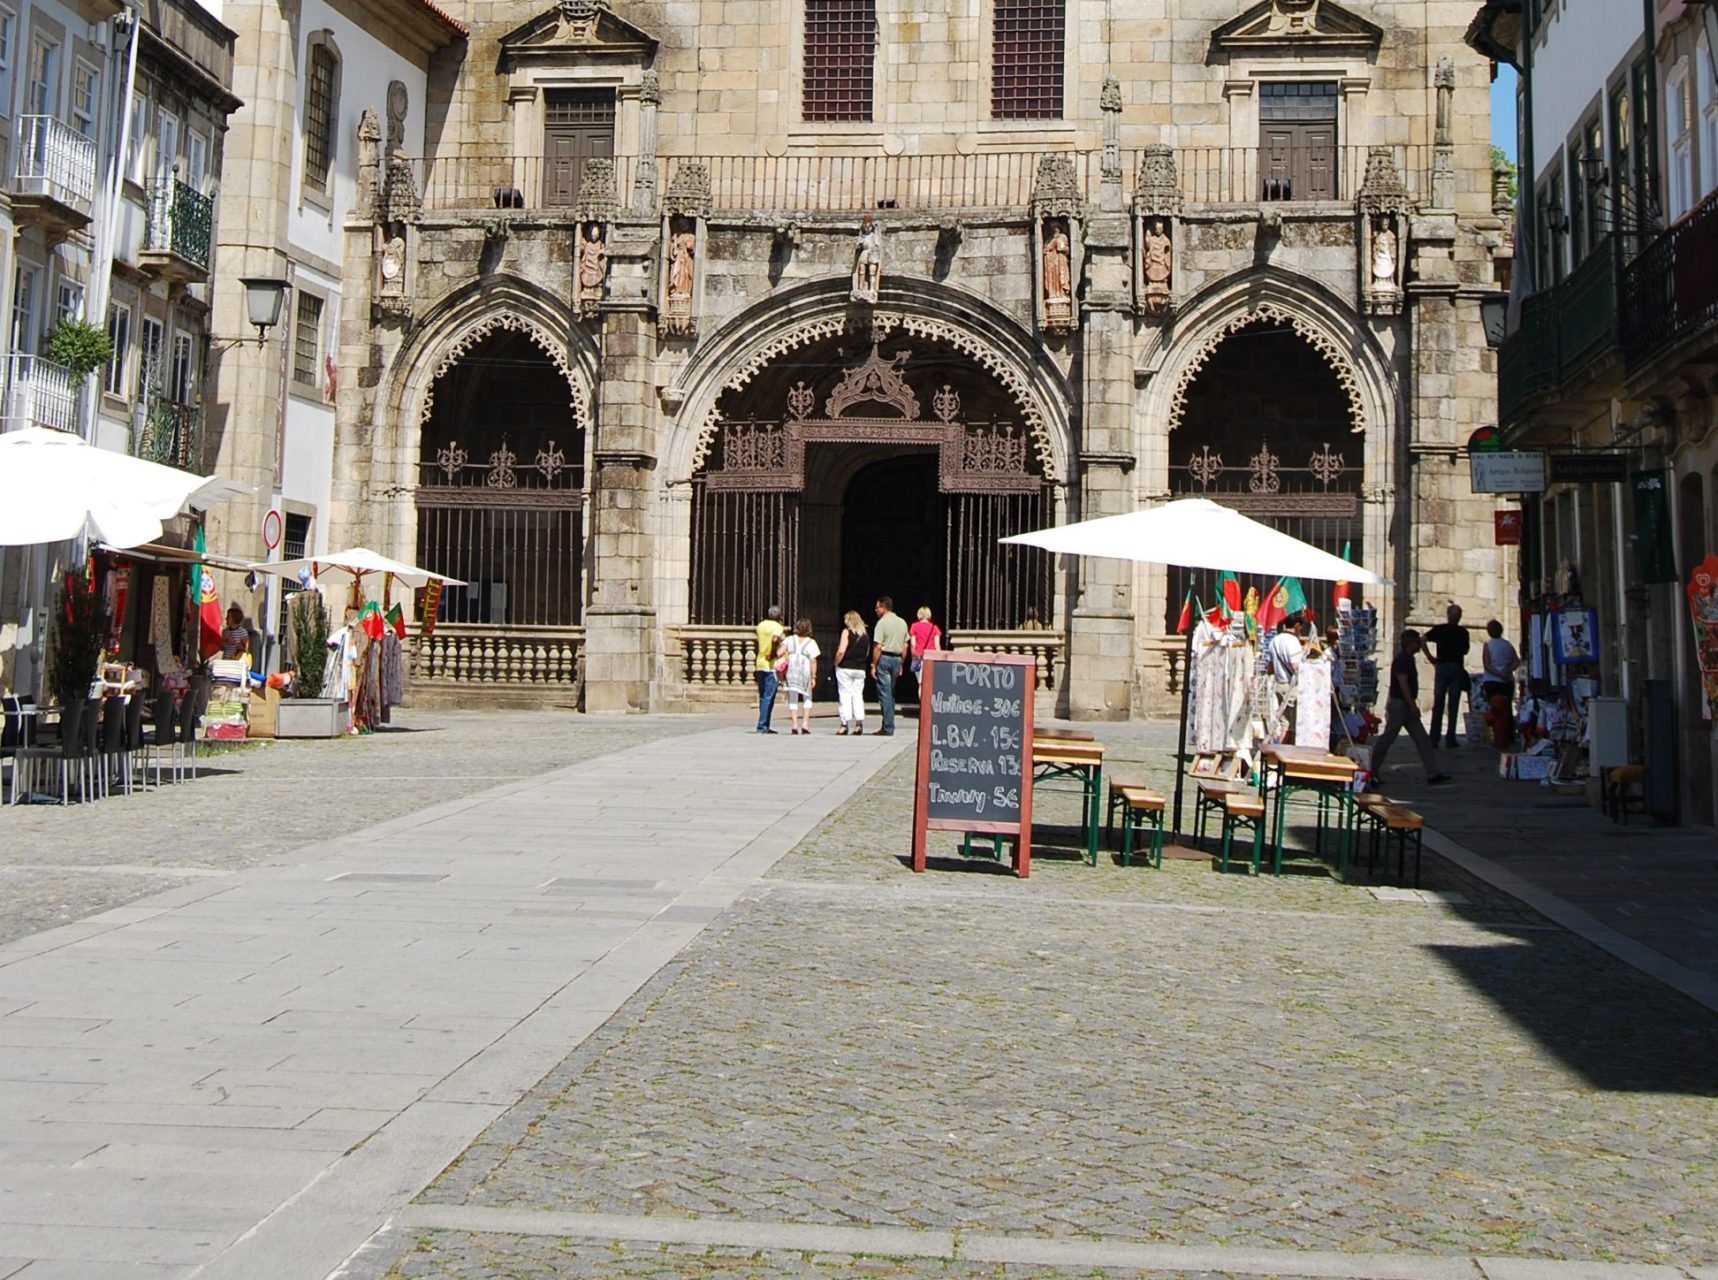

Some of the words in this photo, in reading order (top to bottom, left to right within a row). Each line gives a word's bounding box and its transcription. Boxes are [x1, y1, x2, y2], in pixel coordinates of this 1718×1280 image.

[951, 662, 1015, 690] PORTO
[990, 697, 1021, 718] 30€
[932, 724, 979, 749] L.B.V.
[990, 725, 1020, 751] 15€
[993, 786, 1020, 809] 5€
